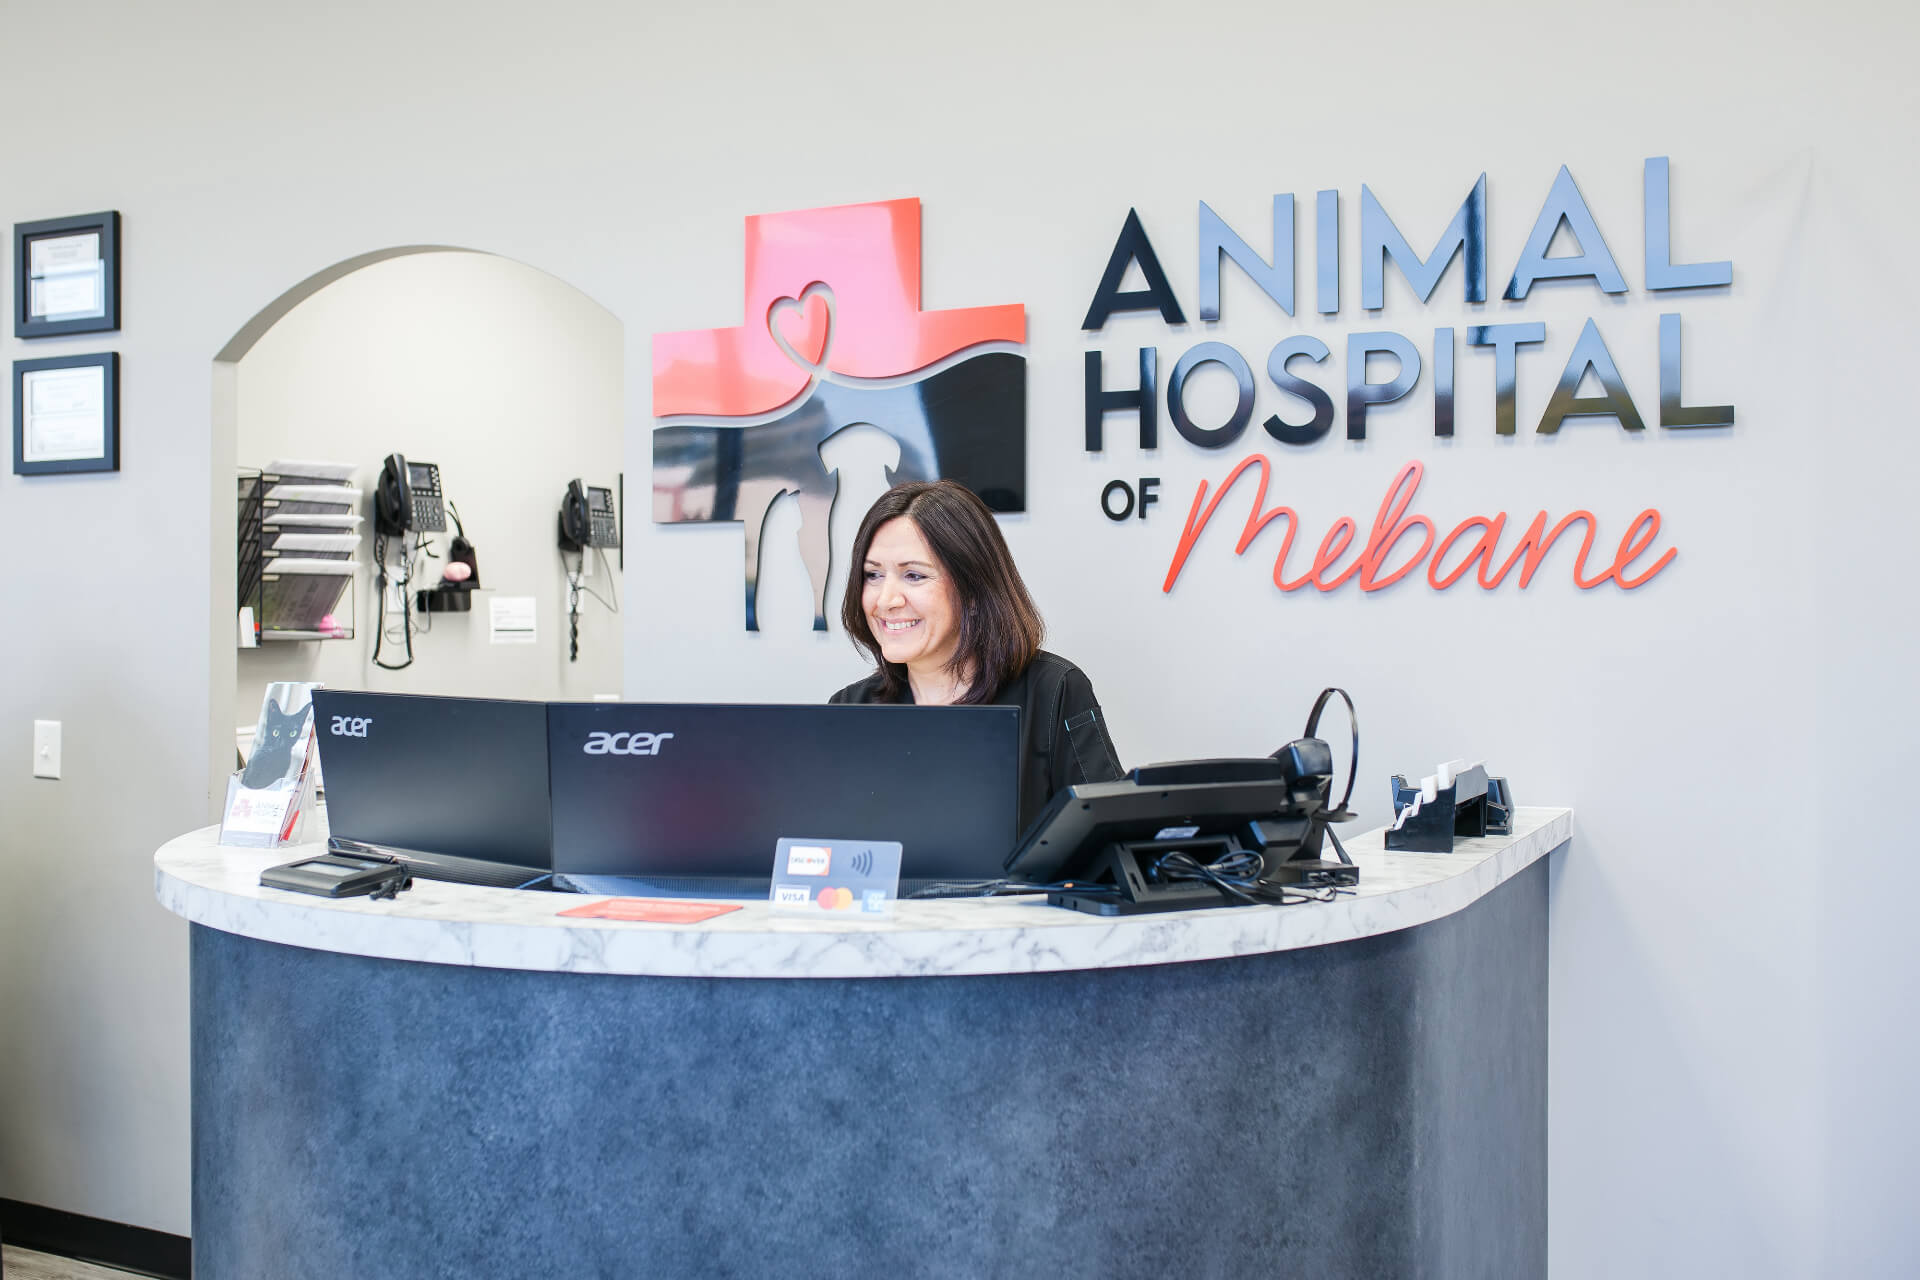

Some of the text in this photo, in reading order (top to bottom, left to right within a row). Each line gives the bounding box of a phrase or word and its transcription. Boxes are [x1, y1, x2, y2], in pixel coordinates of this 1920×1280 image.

[1081, 156, 1732, 331] ANIMAL
[1084, 313, 1735, 452] HOSPITAL
[1101, 453, 1678, 593] OF Mebane
[330, 715, 373, 738] acer
[583, 731, 675, 756] acer
[782, 892, 805, 902] VISA
